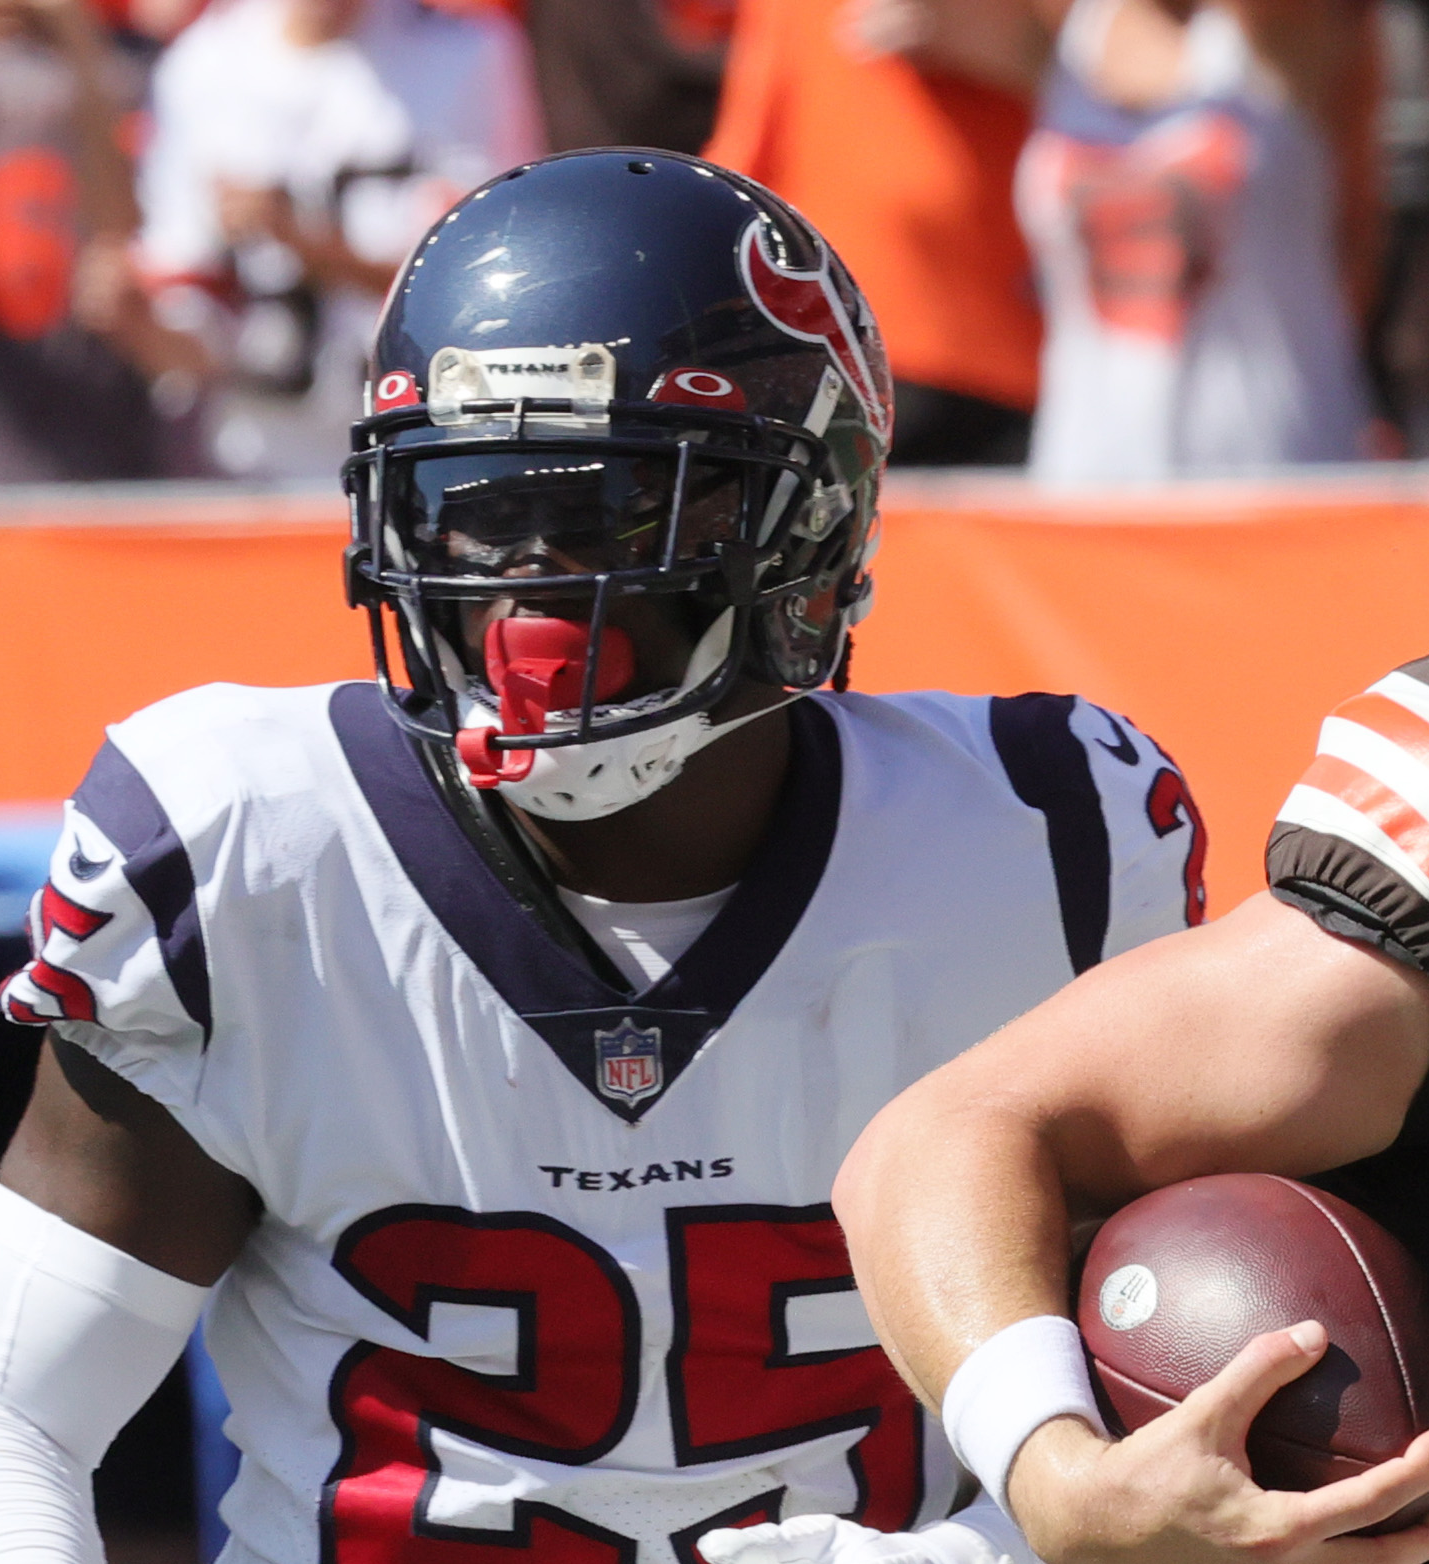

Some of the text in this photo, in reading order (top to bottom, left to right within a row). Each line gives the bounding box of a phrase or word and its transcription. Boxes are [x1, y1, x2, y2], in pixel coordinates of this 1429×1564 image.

[485, 362, 569, 374] TEXANS
[605, 1057, 655, 1090] NFL
[538, 1157, 734, 1191] TEXANS
